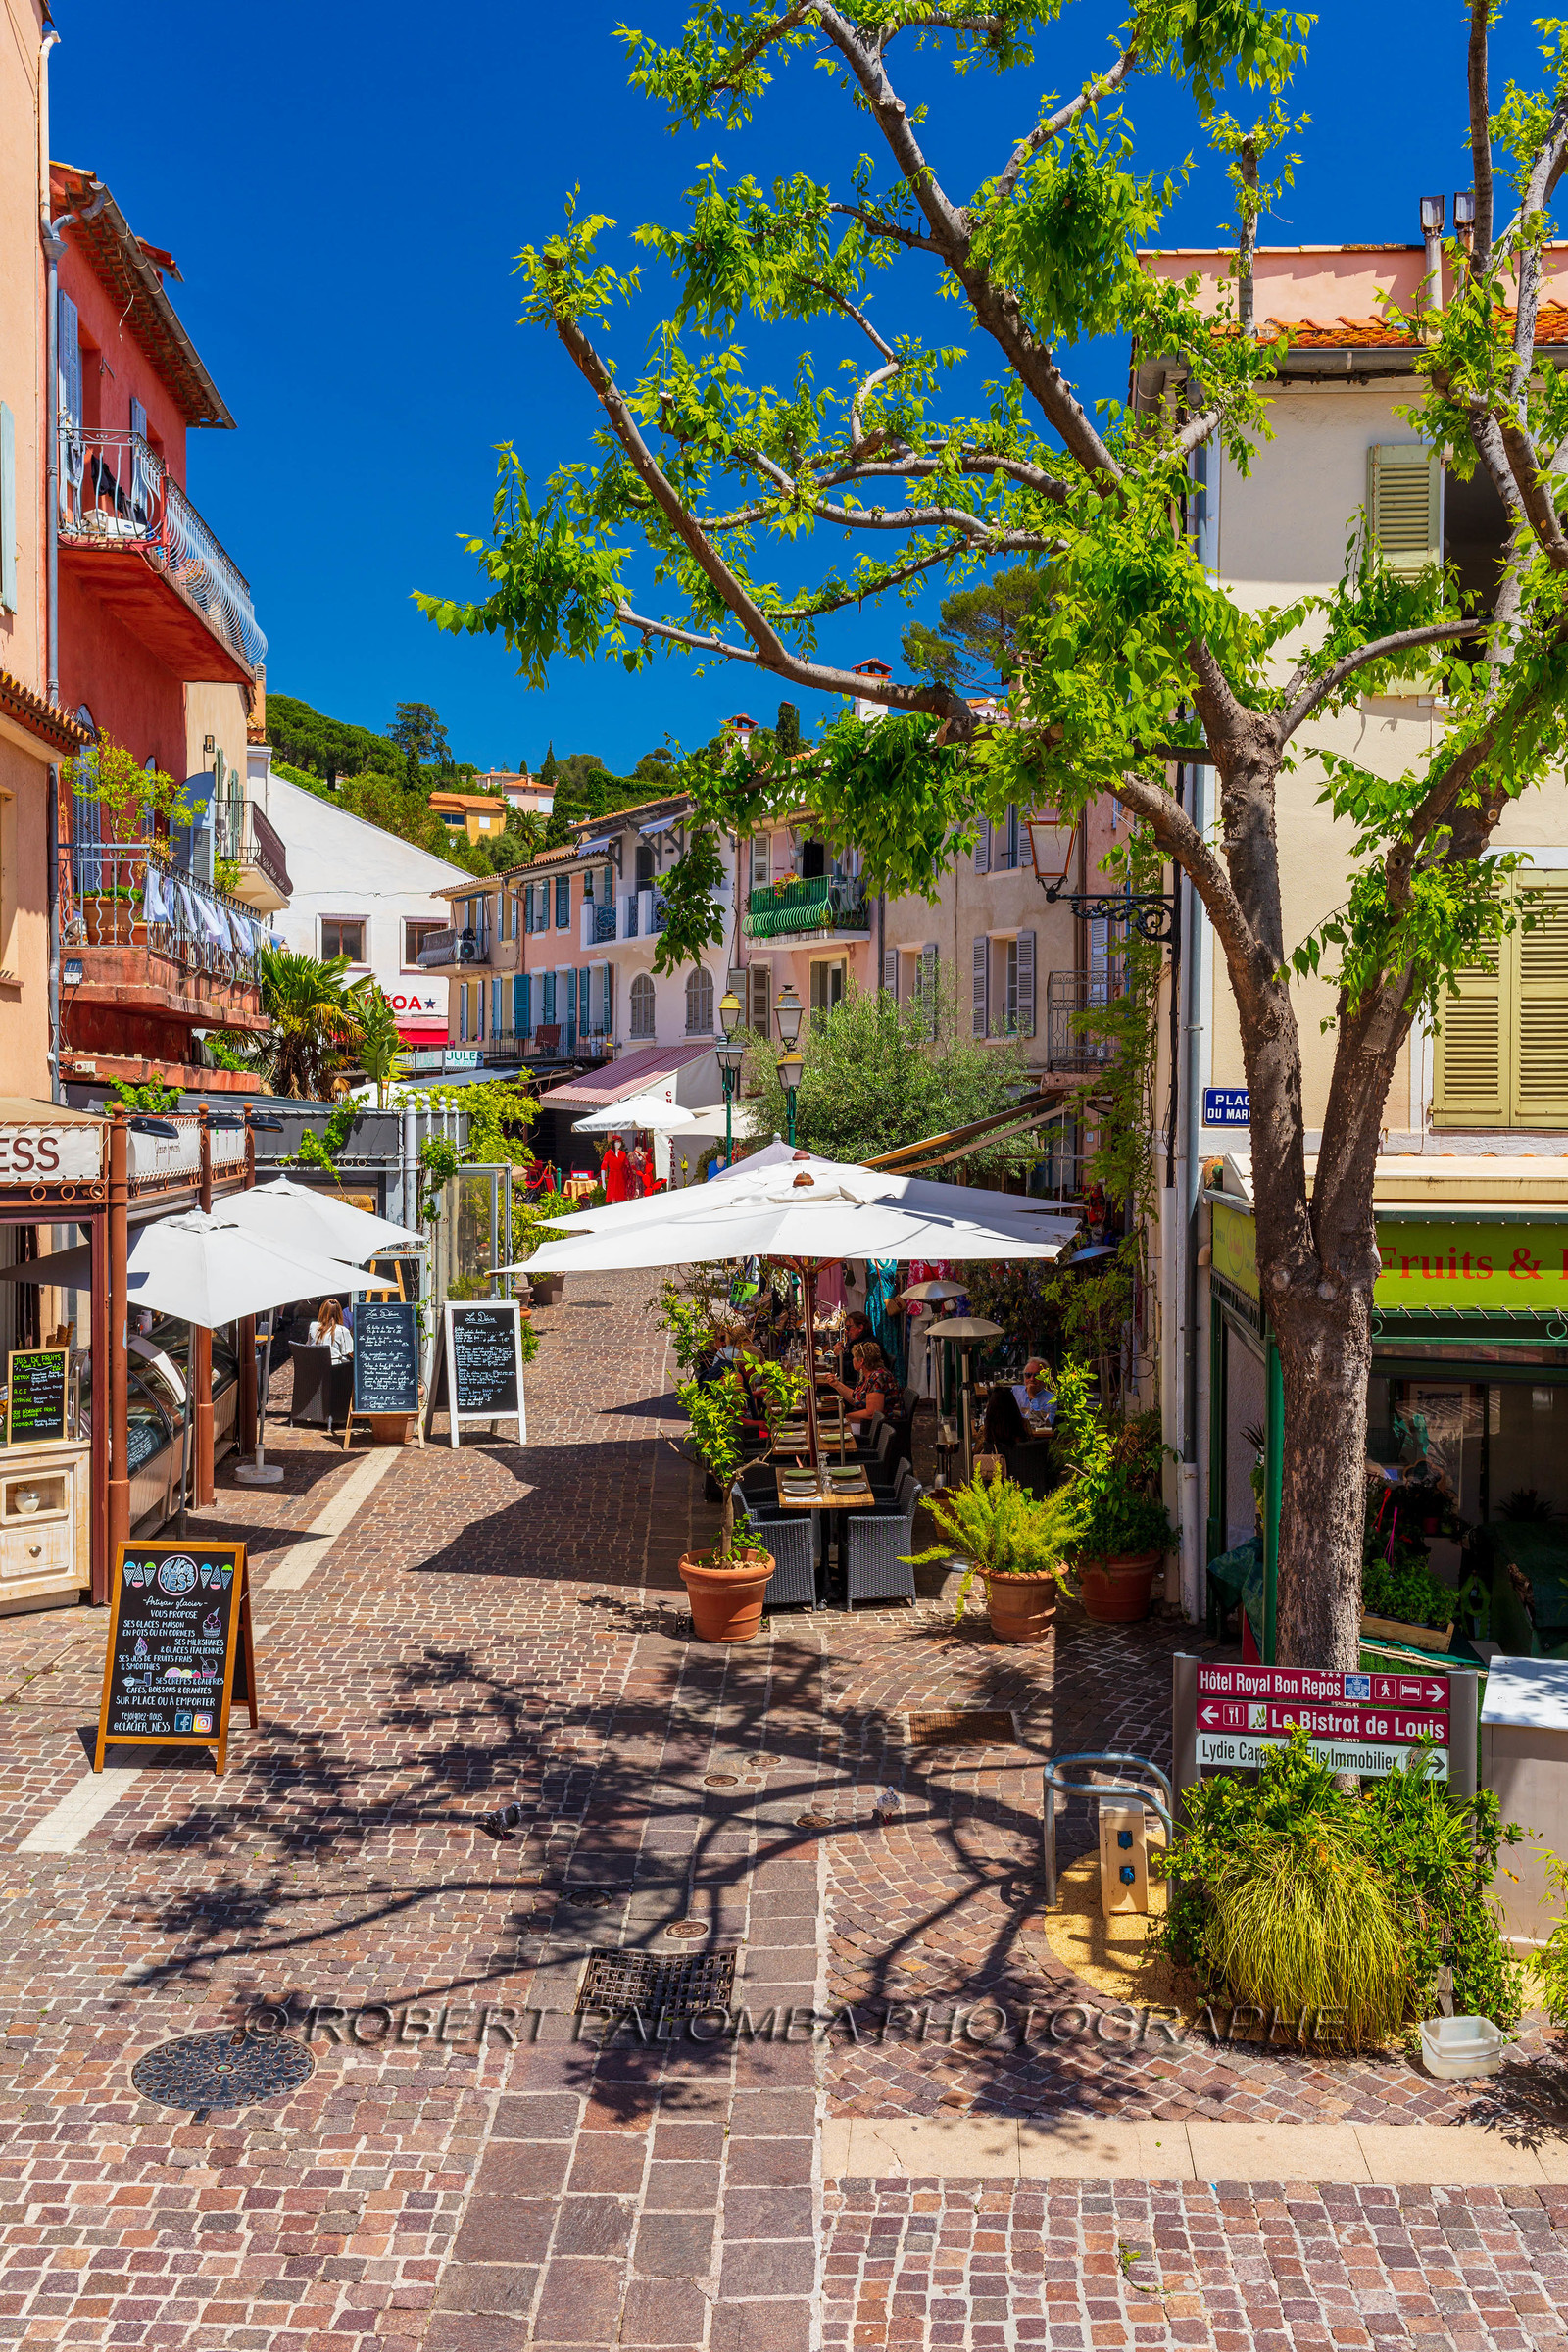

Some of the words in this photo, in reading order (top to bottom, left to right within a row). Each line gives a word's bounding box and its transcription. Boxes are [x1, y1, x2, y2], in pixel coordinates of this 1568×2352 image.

[446, 1052, 484, 1061] JULES
[1215, 1095, 1250, 1106] PLAC
[1207, 1108, 1222, 1119] DU
[1226, 1108, 1251, 1120] MAR
[1377, 1246, 1494, 1280] Fruits
[1508, 1247, 1544, 1280] &
[160, 1571, 195, 1592] NESS
[145, 1595, 174, 1606] Artisan
[150, 1609, 168, 1619] VOUS
[169, 1610, 199, 1620] PROPOSE
[135, 1620, 160, 1629] GLACES
[169, 1629, 196, 1638] CORNETS
[174, 1638, 186, 1646] SES
[118, 1654, 130, 1663] SES
[130, 1654, 142, 1663] JUS
[144, 1654, 152, 1663] DE
[125, 1662, 161, 1671] SMOOTHIES
[1200, 1670, 1232, 1690] Hôtel
[1236, 1672, 1270, 1696] Royal
[1274, 1674, 1298, 1694] Bon
[1301, 1676, 1342, 1700] Repos
[116, 1695, 130, 1705] SUR
[131, 1696, 156, 1706] PLACE
[157, 1696, 169, 1706] OU
[169, 1695, 175, 1706] À
[175, 1697, 216, 1707] EMPORTER
[1271, 1708, 1293, 1729] Le
[1299, 1710, 1359, 1734] Bistrot
[1365, 1715, 1388, 1735] de
[1395, 1716, 1446, 1739] Louis
[1202, 1740, 1235, 1762] Lydie
[1331, 1748, 1398, 1771] Immobilier
